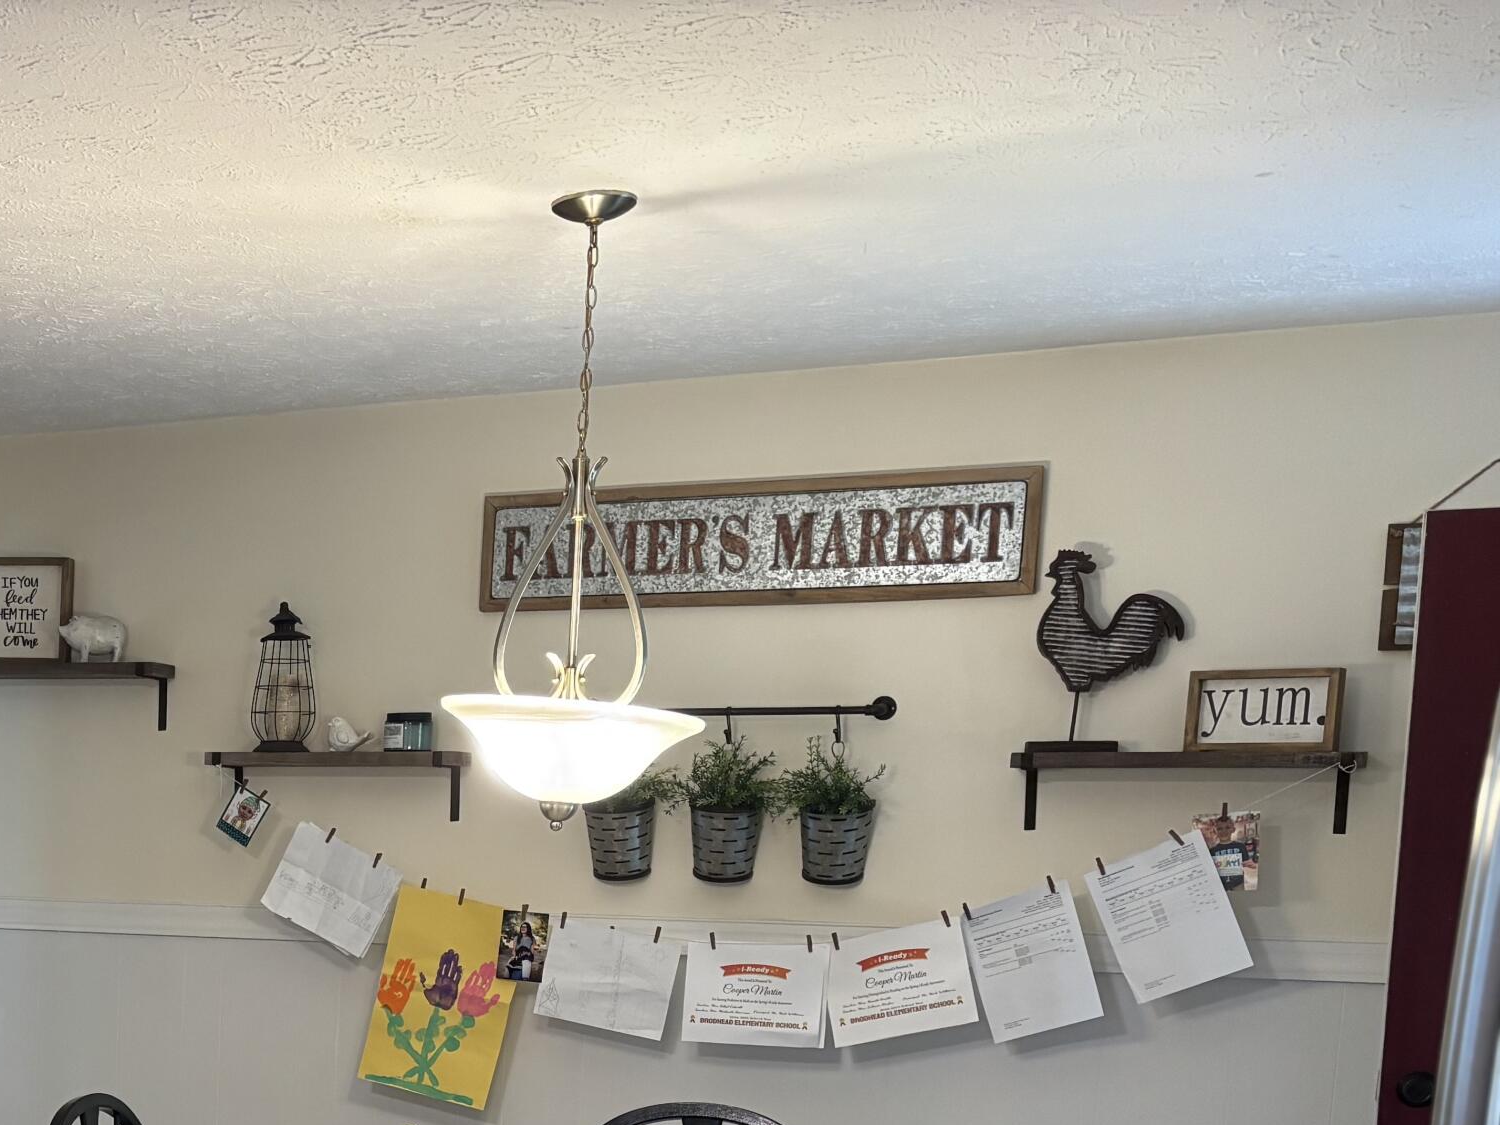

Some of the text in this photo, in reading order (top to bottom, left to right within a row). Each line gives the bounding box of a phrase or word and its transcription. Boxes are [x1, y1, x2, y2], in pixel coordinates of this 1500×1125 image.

[770, 502, 1016, 571] MARKET
[1, 576, 39, 588] IF YOU
[4, 588, 38, 607] feed
[20, 608, 48, 621] THEY
[6, 622, 35, 634] WILL
[3, 635, 39, 649] come
[1201, 687, 1326, 738] yum.
[865, 977, 894, 989] Cooper
[893, 970, 927, 983] Martin
[723, 983, 782, 996] Cooper Martin
[886, 1004, 928, 1018] ELEMENTARY
[928, 999, 956, 1011] SCHOOL
[734, 1019, 774, 1029] ELEMENTARY
[775, 1021, 801, 1030] SCHOOL
